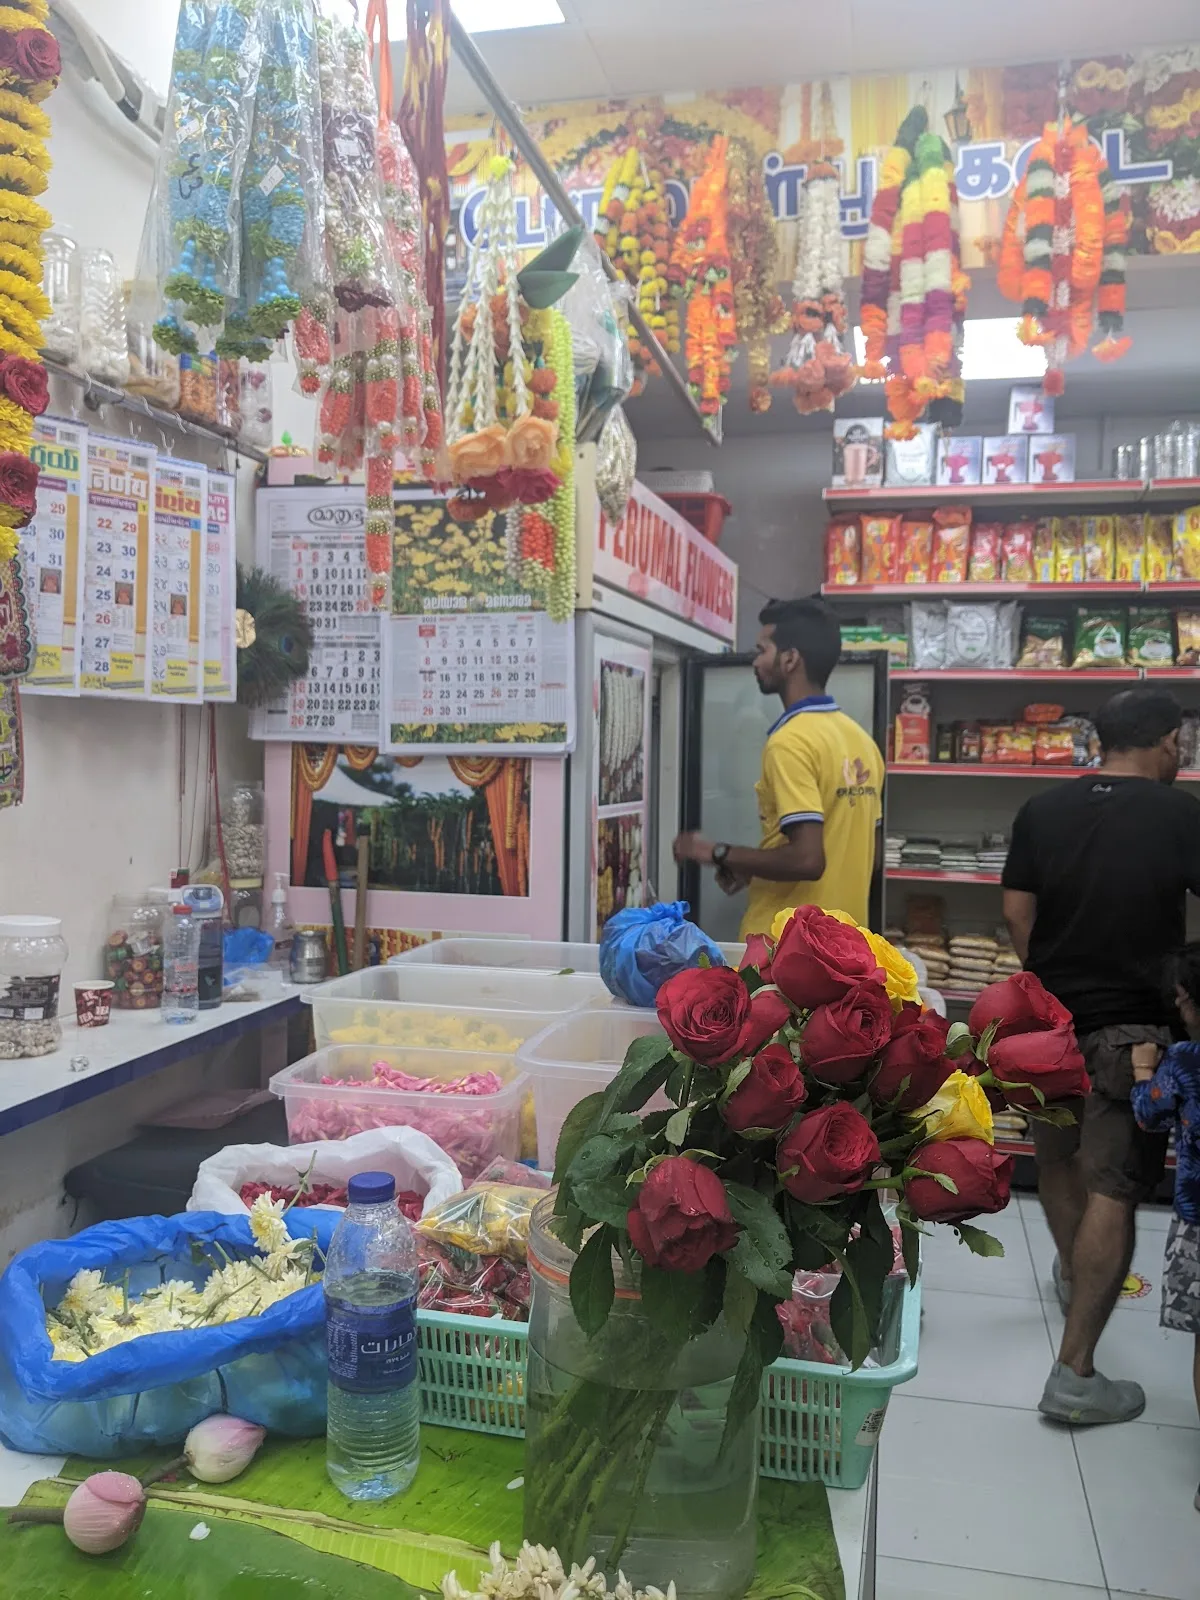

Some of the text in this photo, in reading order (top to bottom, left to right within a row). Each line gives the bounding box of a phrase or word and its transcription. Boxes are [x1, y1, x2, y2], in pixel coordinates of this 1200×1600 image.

[97, 518, 112, 529] 22
[122, 522, 137, 533] 29
[49, 527, 65, 540] 30
[97, 542, 112, 553] 23
[122, 546, 136, 557] 30
[48, 553, 63, 566] 31
[97, 565, 111, 577] 24
[121, 569, 135, 580] 31
[95, 589, 111, 601] 25
[309, 601, 322, 612] 23
[325, 601, 338, 612] 24
[340, 601, 354, 612] 25
[96, 613, 111, 624] 26
[325, 618, 337, 628] 31
[95, 637, 110, 648] 27
[94, 661, 109, 672] 28
[423, 689, 433, 698] 22
[440, 689, 450, 698] 23
[457, 689, 467, 698] 24
[474, 689, 484, 698] 25
[307, 700, 320, 710] 20
[338, 700, 351, 710] 22
[353, 700, 366, 710] 23
[457, 707, 466, 715] 31
[306, 716, 319, 726] 27
